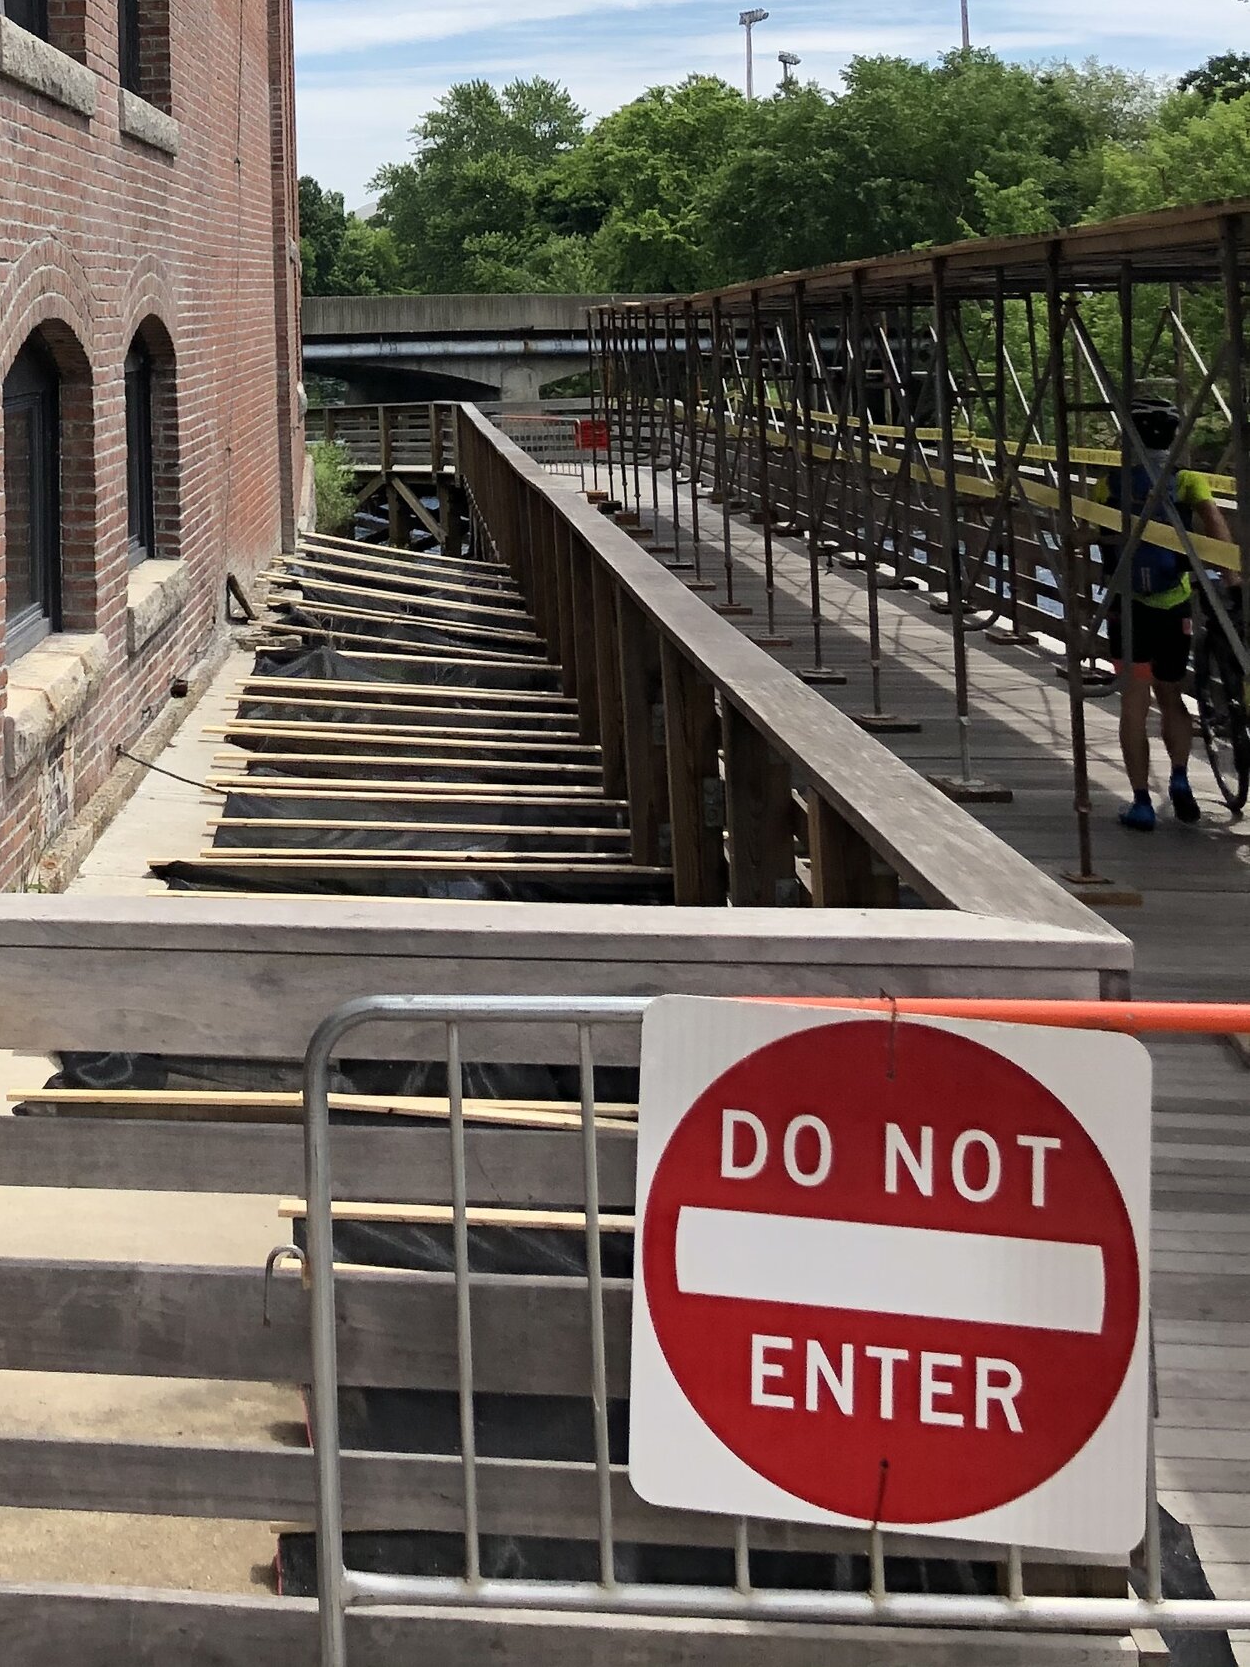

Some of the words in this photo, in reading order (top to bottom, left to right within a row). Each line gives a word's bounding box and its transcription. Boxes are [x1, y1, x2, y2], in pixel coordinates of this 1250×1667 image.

[720, 1108, 833, 1187] DO
[884, 1122, 1062, 1208] NOT
[750, 1333, 1024, 1434] ENTER
